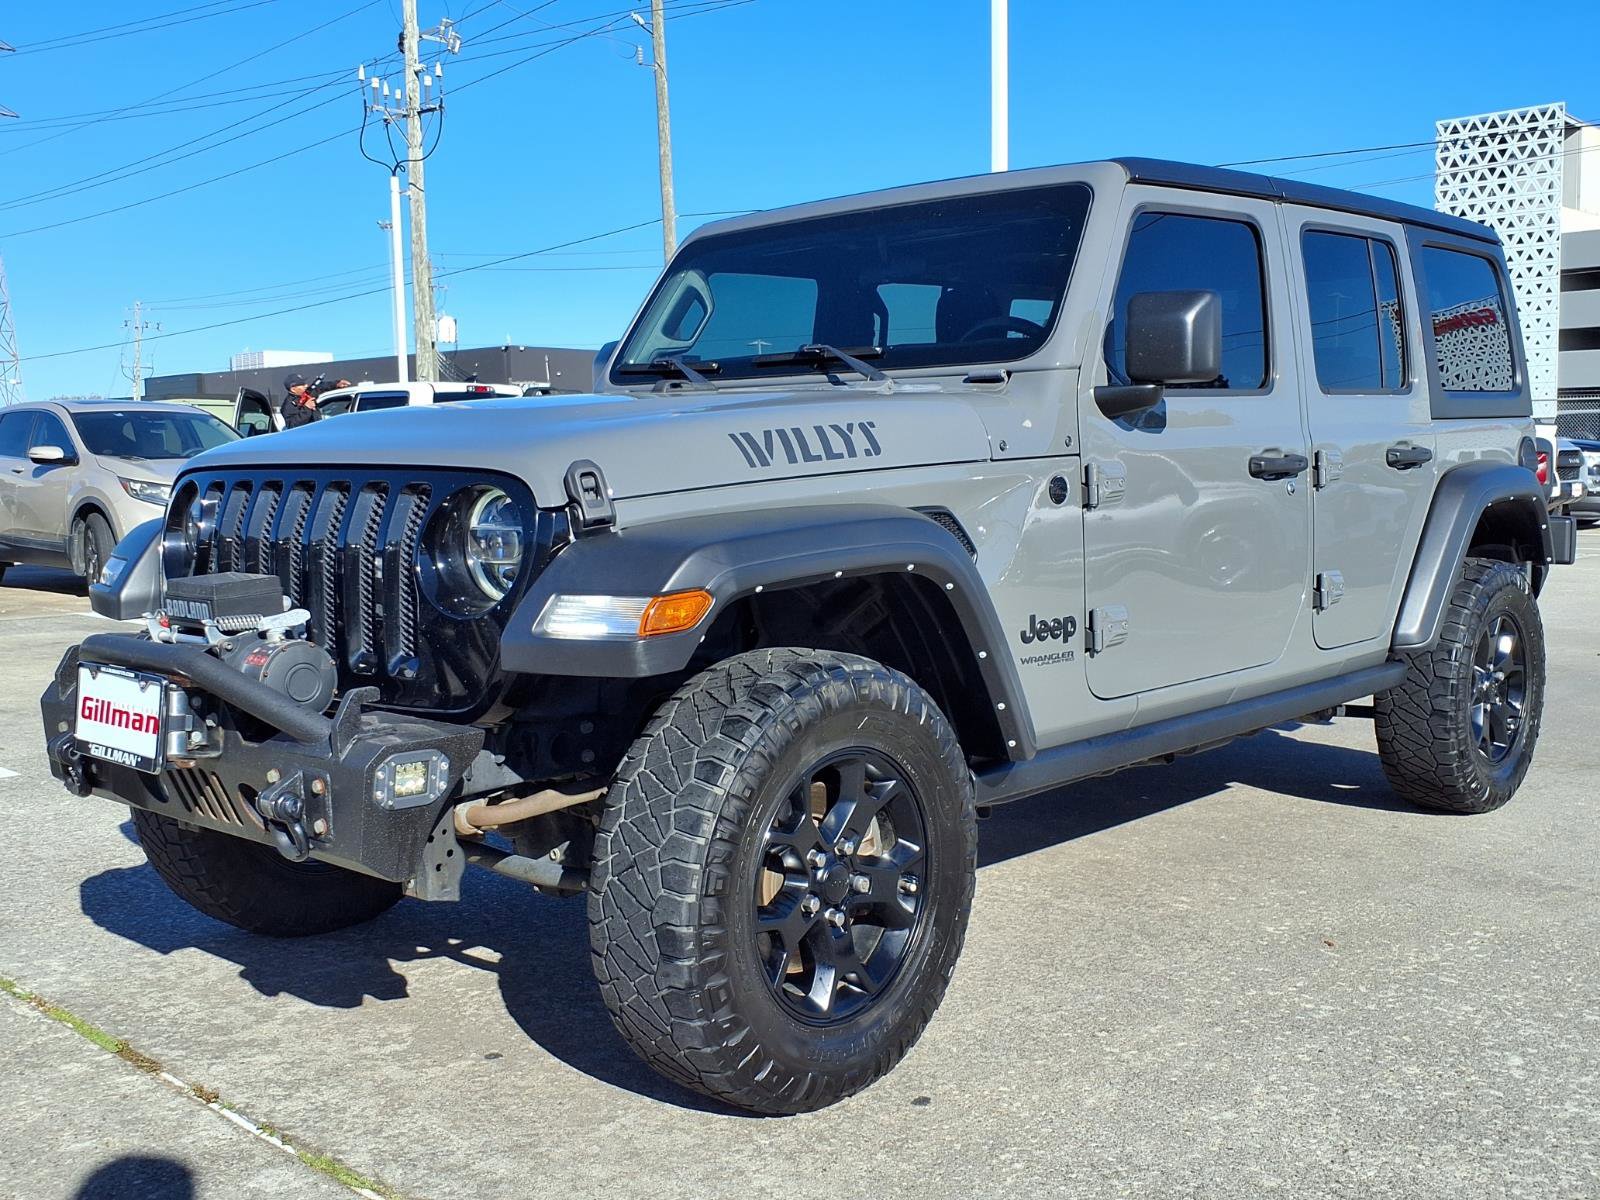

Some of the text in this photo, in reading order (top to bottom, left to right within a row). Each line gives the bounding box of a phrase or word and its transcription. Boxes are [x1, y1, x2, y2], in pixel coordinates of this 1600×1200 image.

[728, 421, 882, 468] WILLYS
[165, 599, 210, 620] BADLAND
[1020, 614, 1077, 644] Jeep
[1020, 651, 1074, 665] WRANGLER
[81, 696, 160, 735] Gillman
[90, 743, 138, 767] GILLMAN
